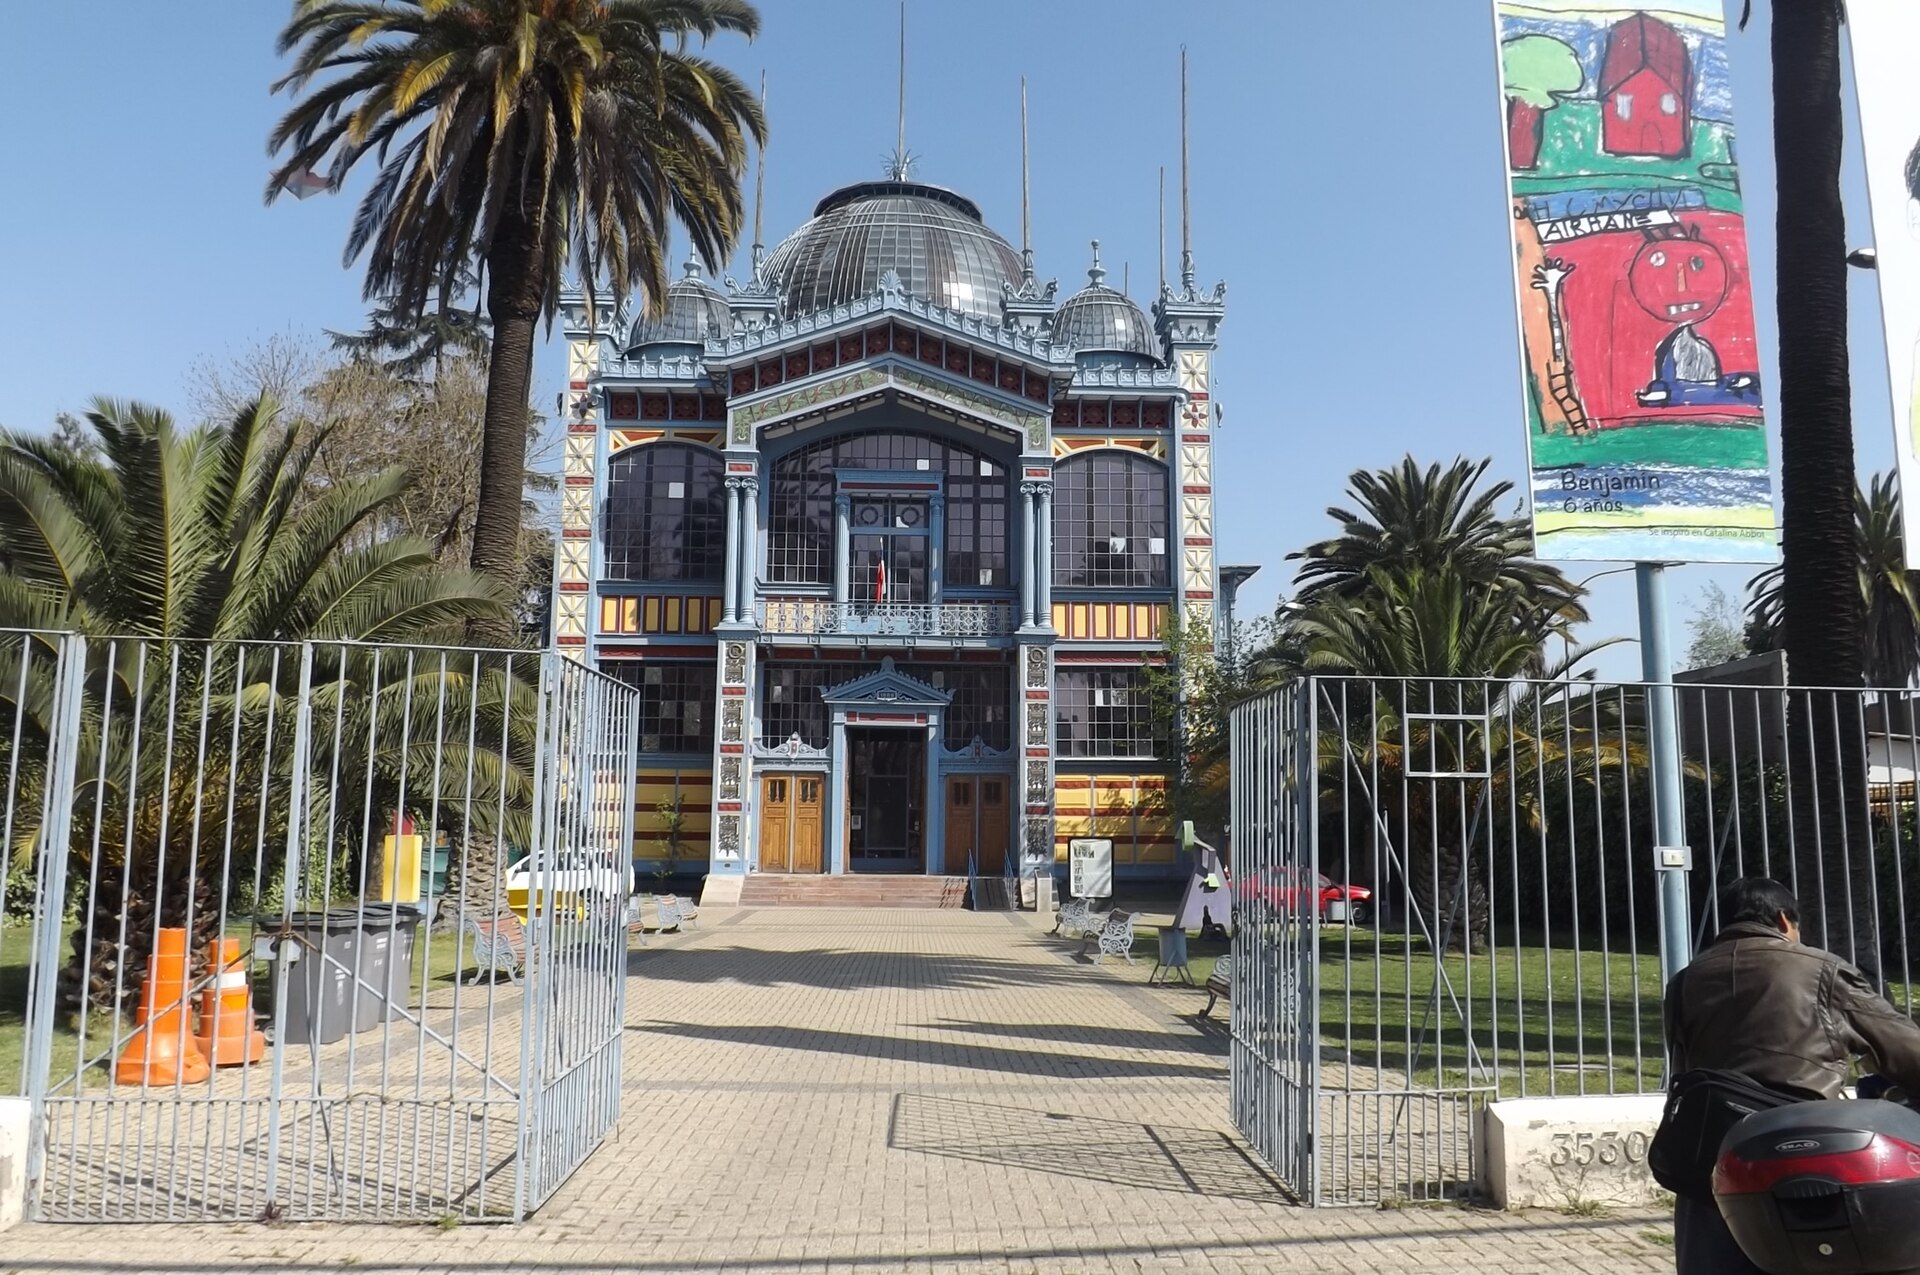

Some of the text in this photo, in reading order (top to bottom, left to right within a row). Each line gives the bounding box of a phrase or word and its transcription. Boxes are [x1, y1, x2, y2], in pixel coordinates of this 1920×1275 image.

[1563, 497, 1623, 513] 6 años
[1648, 526, 1659, 536] Se
[1691, 529, 1703, 537] en
[1704, 527, 1738, 538] Catalina
[1551, 1131, 1648, 1167] 3530
